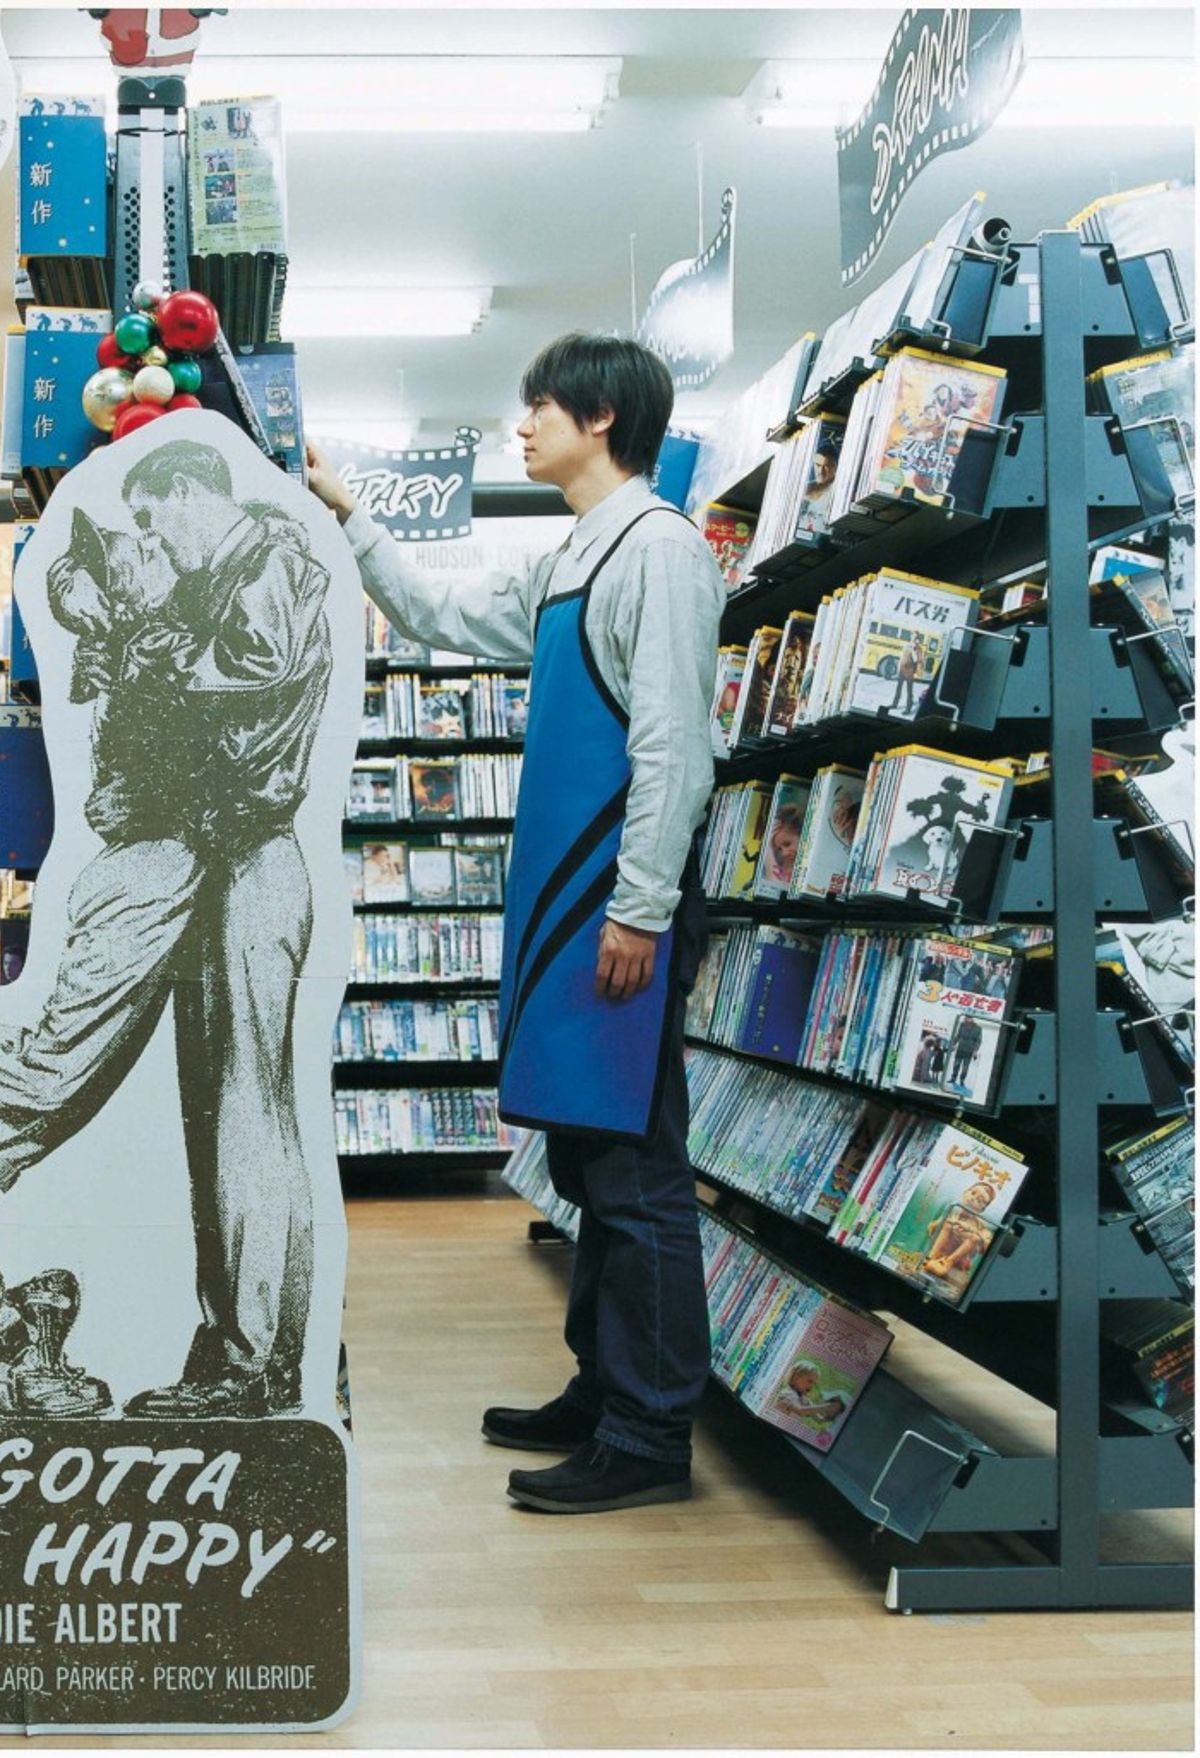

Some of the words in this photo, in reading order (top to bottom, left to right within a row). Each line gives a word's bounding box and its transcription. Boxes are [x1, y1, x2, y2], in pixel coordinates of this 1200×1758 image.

[28, 162, 52, 225] 新作
[32, 376, 57, 439] 新作
[416, 545, 482, 569] HUDSON
[54, 1603, 183, 1643] ALBERT
[56, 1666, 134, 1691] PARKER
[153, 1666, 217, 1690] PERCY
[226, 1665, 316, 1690] KILBRIDE
